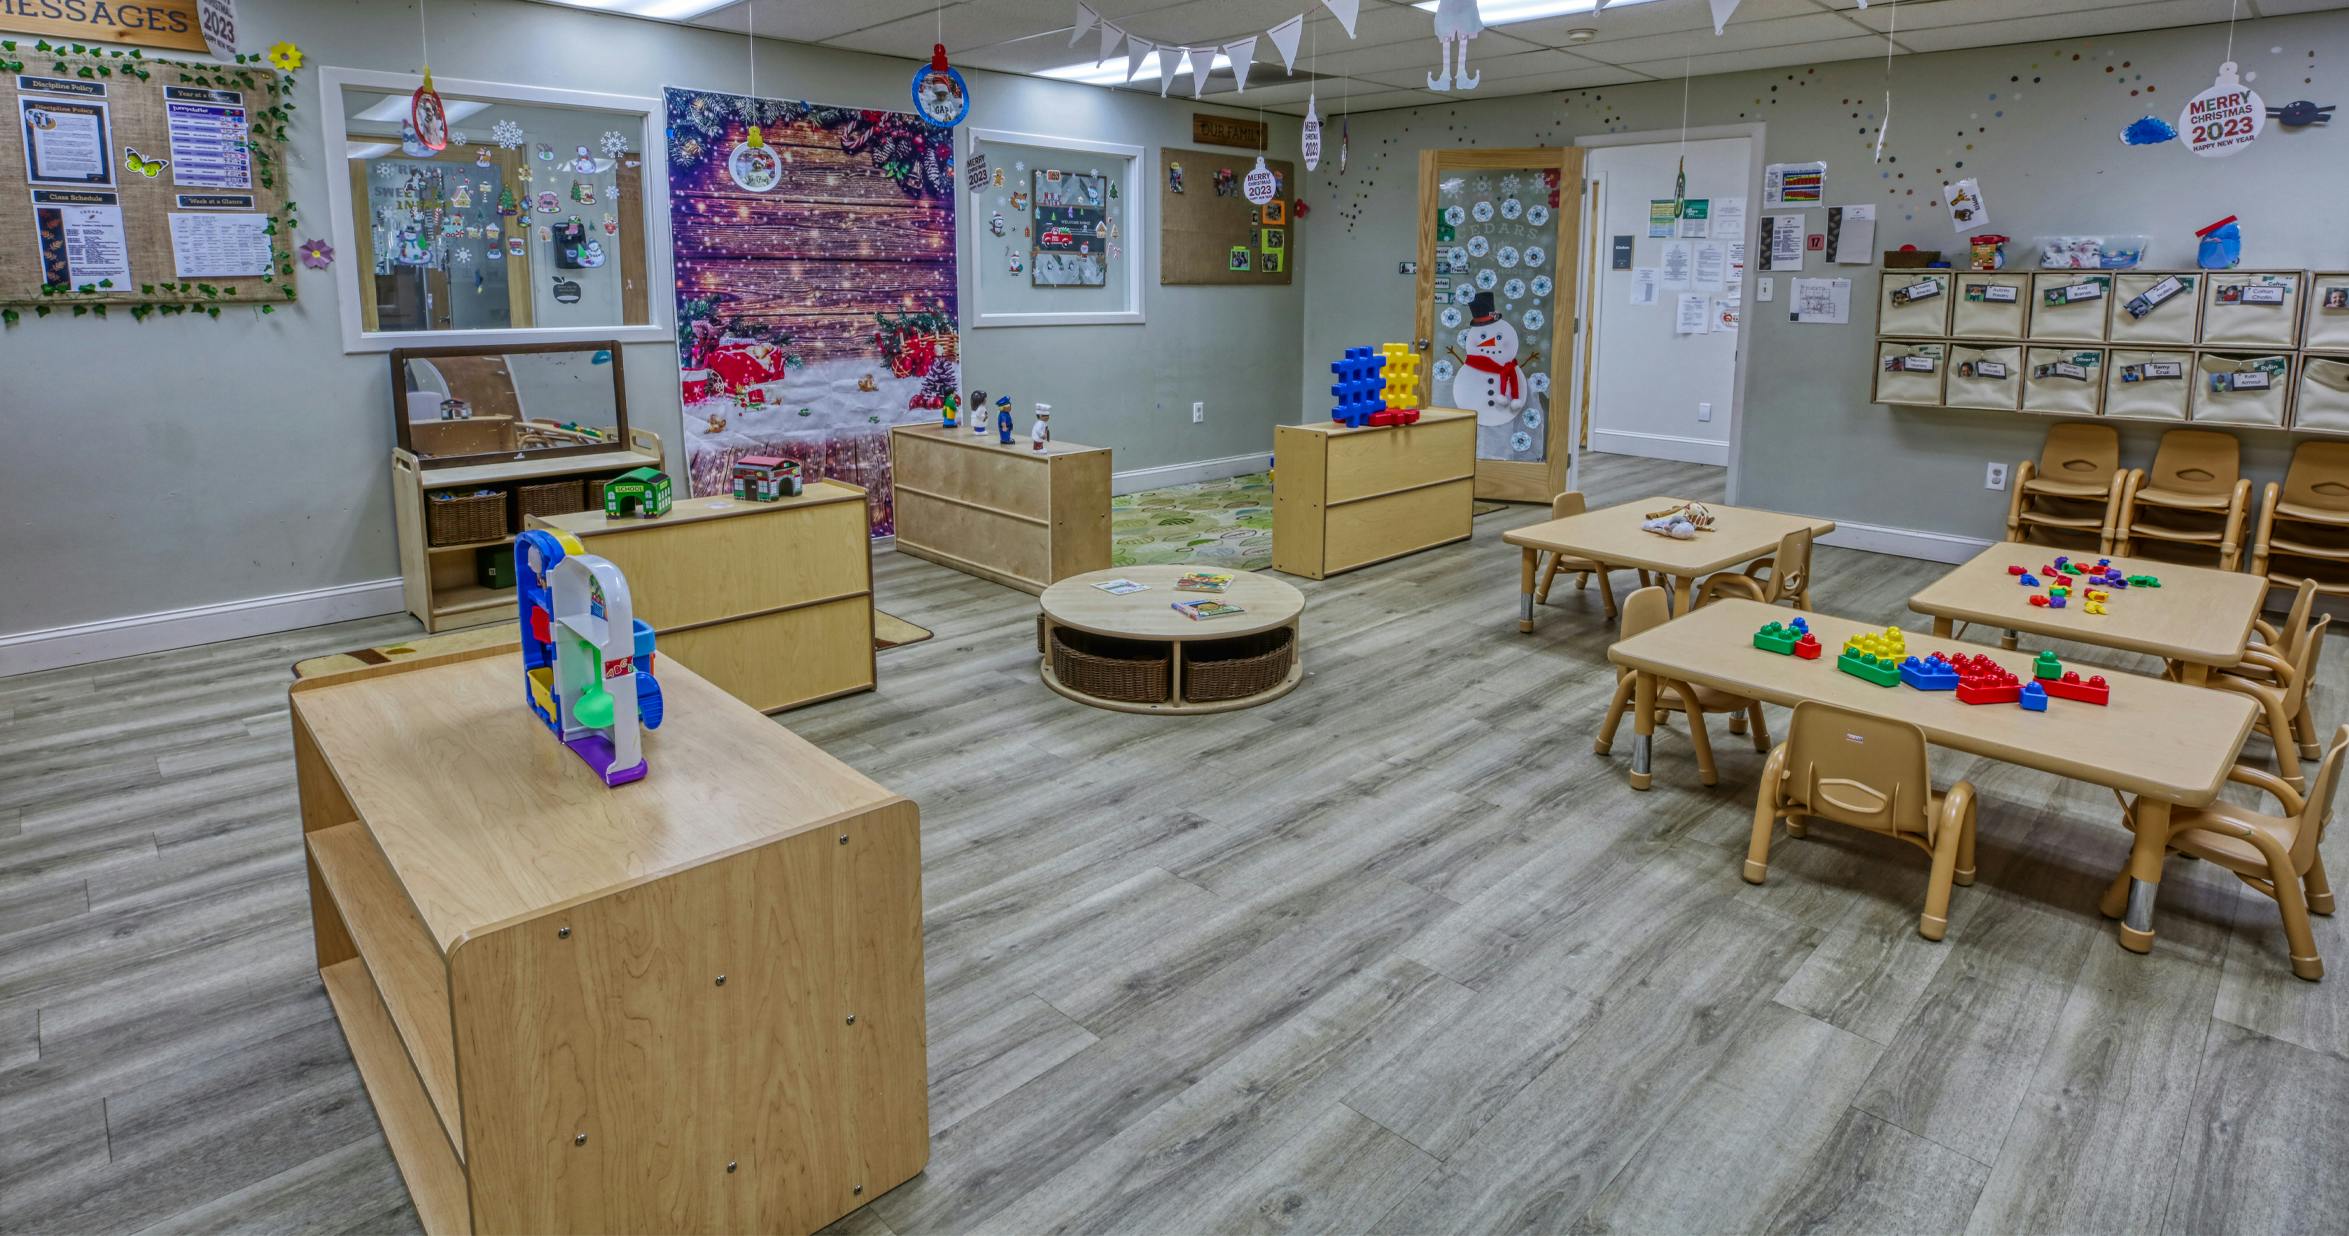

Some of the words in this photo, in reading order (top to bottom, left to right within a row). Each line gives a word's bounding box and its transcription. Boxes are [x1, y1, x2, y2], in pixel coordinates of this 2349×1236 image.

[203, 7, 235, 44] 2023
[32, 81, 70, 91] Discipline
[71, 84, 93, 93] Policy
[34, 103, 71, 112] Discipline
[2190, 89, 2251, 116] MERRY
[2191, 104, 2253, 125] CHRISTMAS
[1201, 123, 1225, 138] OUR
[2192, 116, 2254, 145] 2023
[1305, 142, 1319, 157] 2023
[2193, 142, 2216, 153] HAPPY
[2217, 139, 2234, 148] NEW
[2236, 135, 2255, 144] YEAR
[967, 154, 985, 169] MERRY
[969, 169, 988, 186] 2023
[1247, 172, 1271, 182] MERRY
[1248, 179, 1272, 187] CHRISTMAS
[1249, 185, 1272, 197] 2023
[1456, 222, 1538, 240] CEDARS
[1811, 237, 1821, 248] 17
